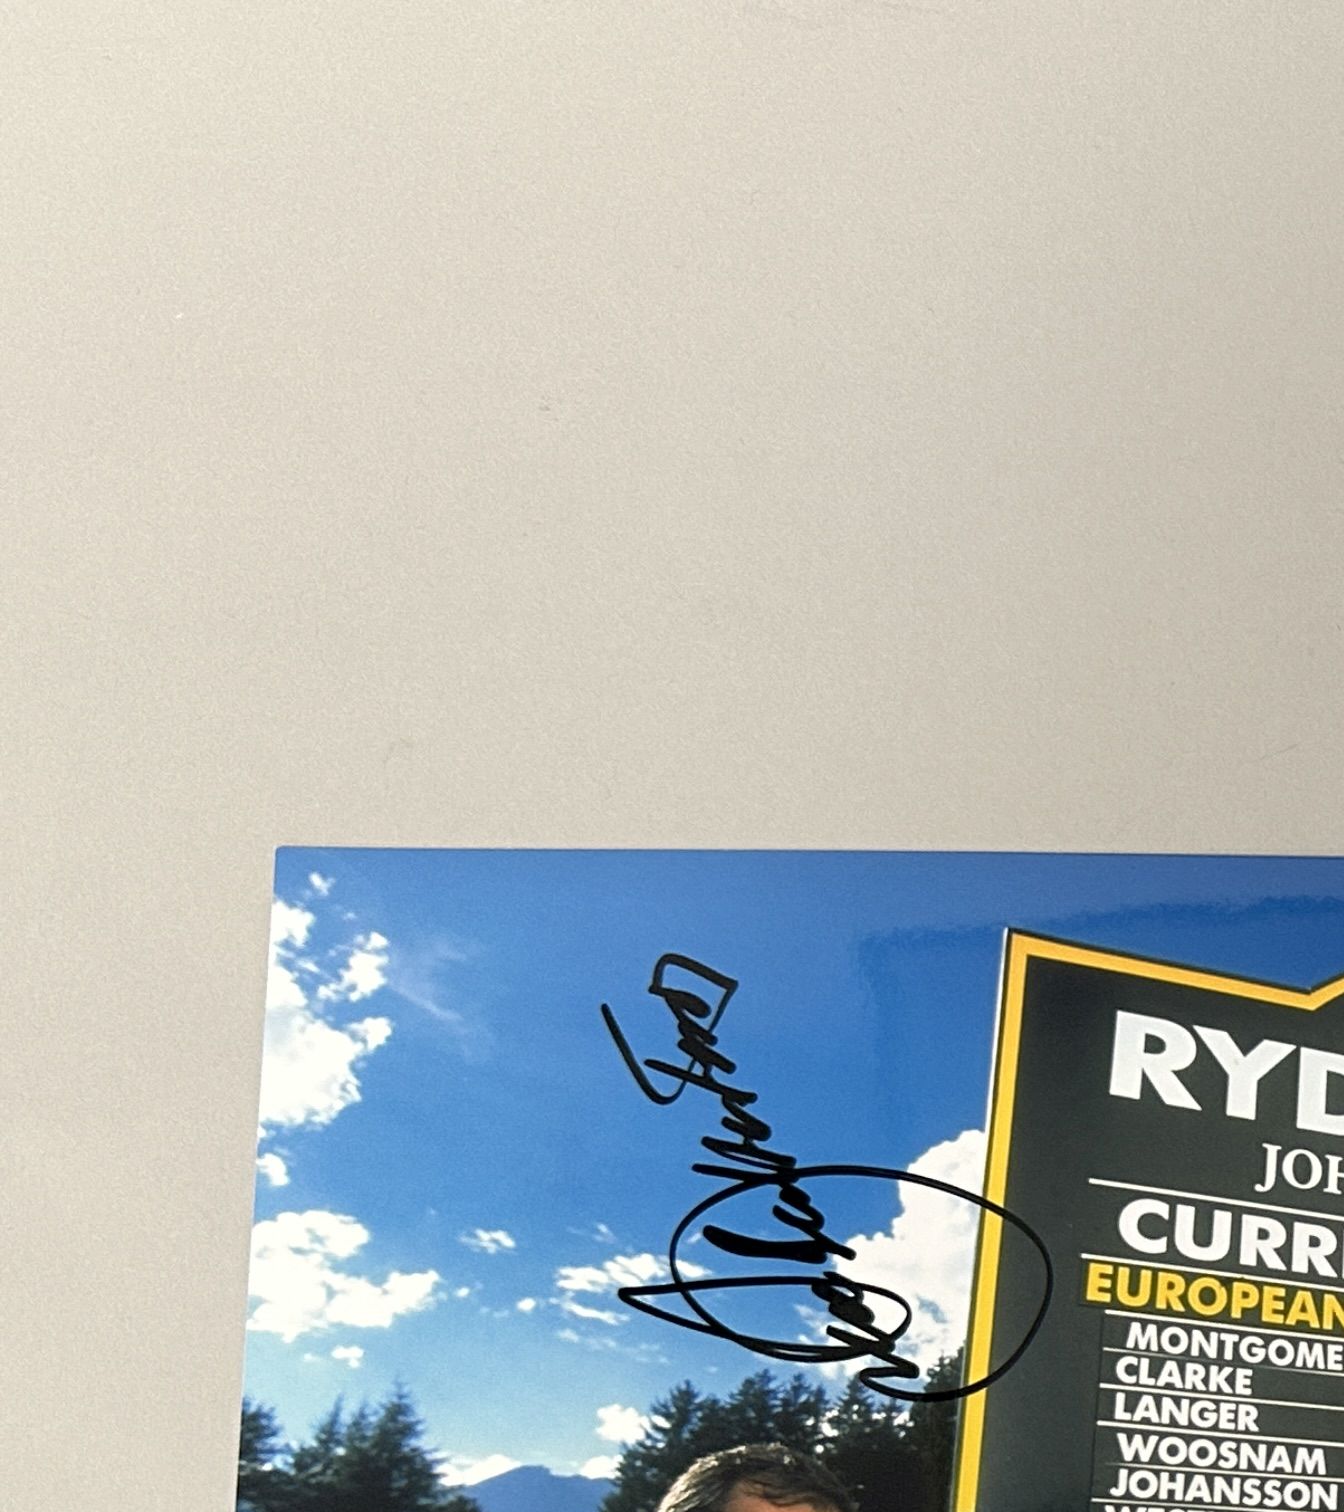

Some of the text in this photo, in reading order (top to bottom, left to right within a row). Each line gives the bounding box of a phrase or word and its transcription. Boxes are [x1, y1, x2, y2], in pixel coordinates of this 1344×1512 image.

[1116, 1356, 1253, 1395] CLARKE
[1114, 1392, 1259, 1432] LANGER
[1117, 1433, 1326, 1475] WOOSNAM
[1110, 1469, 1338, 1510] JOHANSSON
